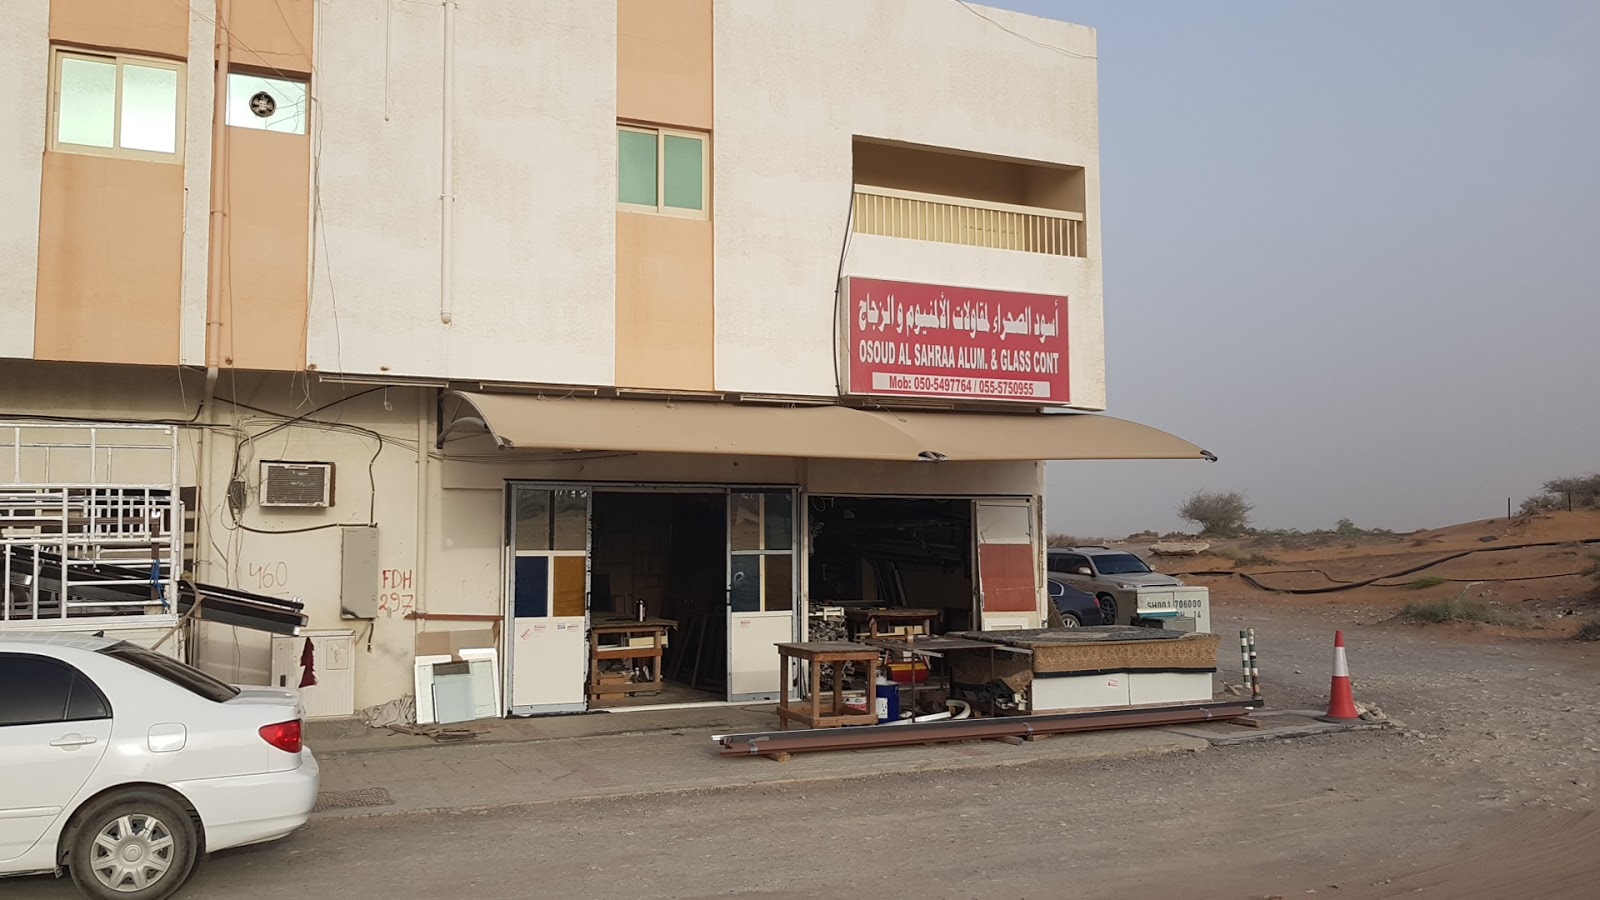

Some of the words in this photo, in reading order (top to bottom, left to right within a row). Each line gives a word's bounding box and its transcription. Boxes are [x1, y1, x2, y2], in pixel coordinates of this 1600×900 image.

[858, 292, 895, 333] الزجاج
[896, 302, 904, 334] و
[952, 299, 991, 340] لمقاولات
[992, 303, 1032, 341] الصحراء
[1034, 299, 1059, 344] أسود
[859, 339, 896, 365] OSOUD
[898, 342, 912, 366] AL
[914, 342, 956, 369] SAHRAA
[958, 346, 988, 370] ALUM.
[990, 348, 998, 370] &
[1000, 348, 1032, 373] GLASS
[1033, 351, 1060, 374] CONT
[889, 374, 912, 390] Mob:
[914, 376, 972, 393] 050-5497764
[979, 380, 1034, 396] 055-5750955
[249, 561, 288, 590] 460
[382, 569, 413, 590] FDH
[378, 592, 414, 615] 297
